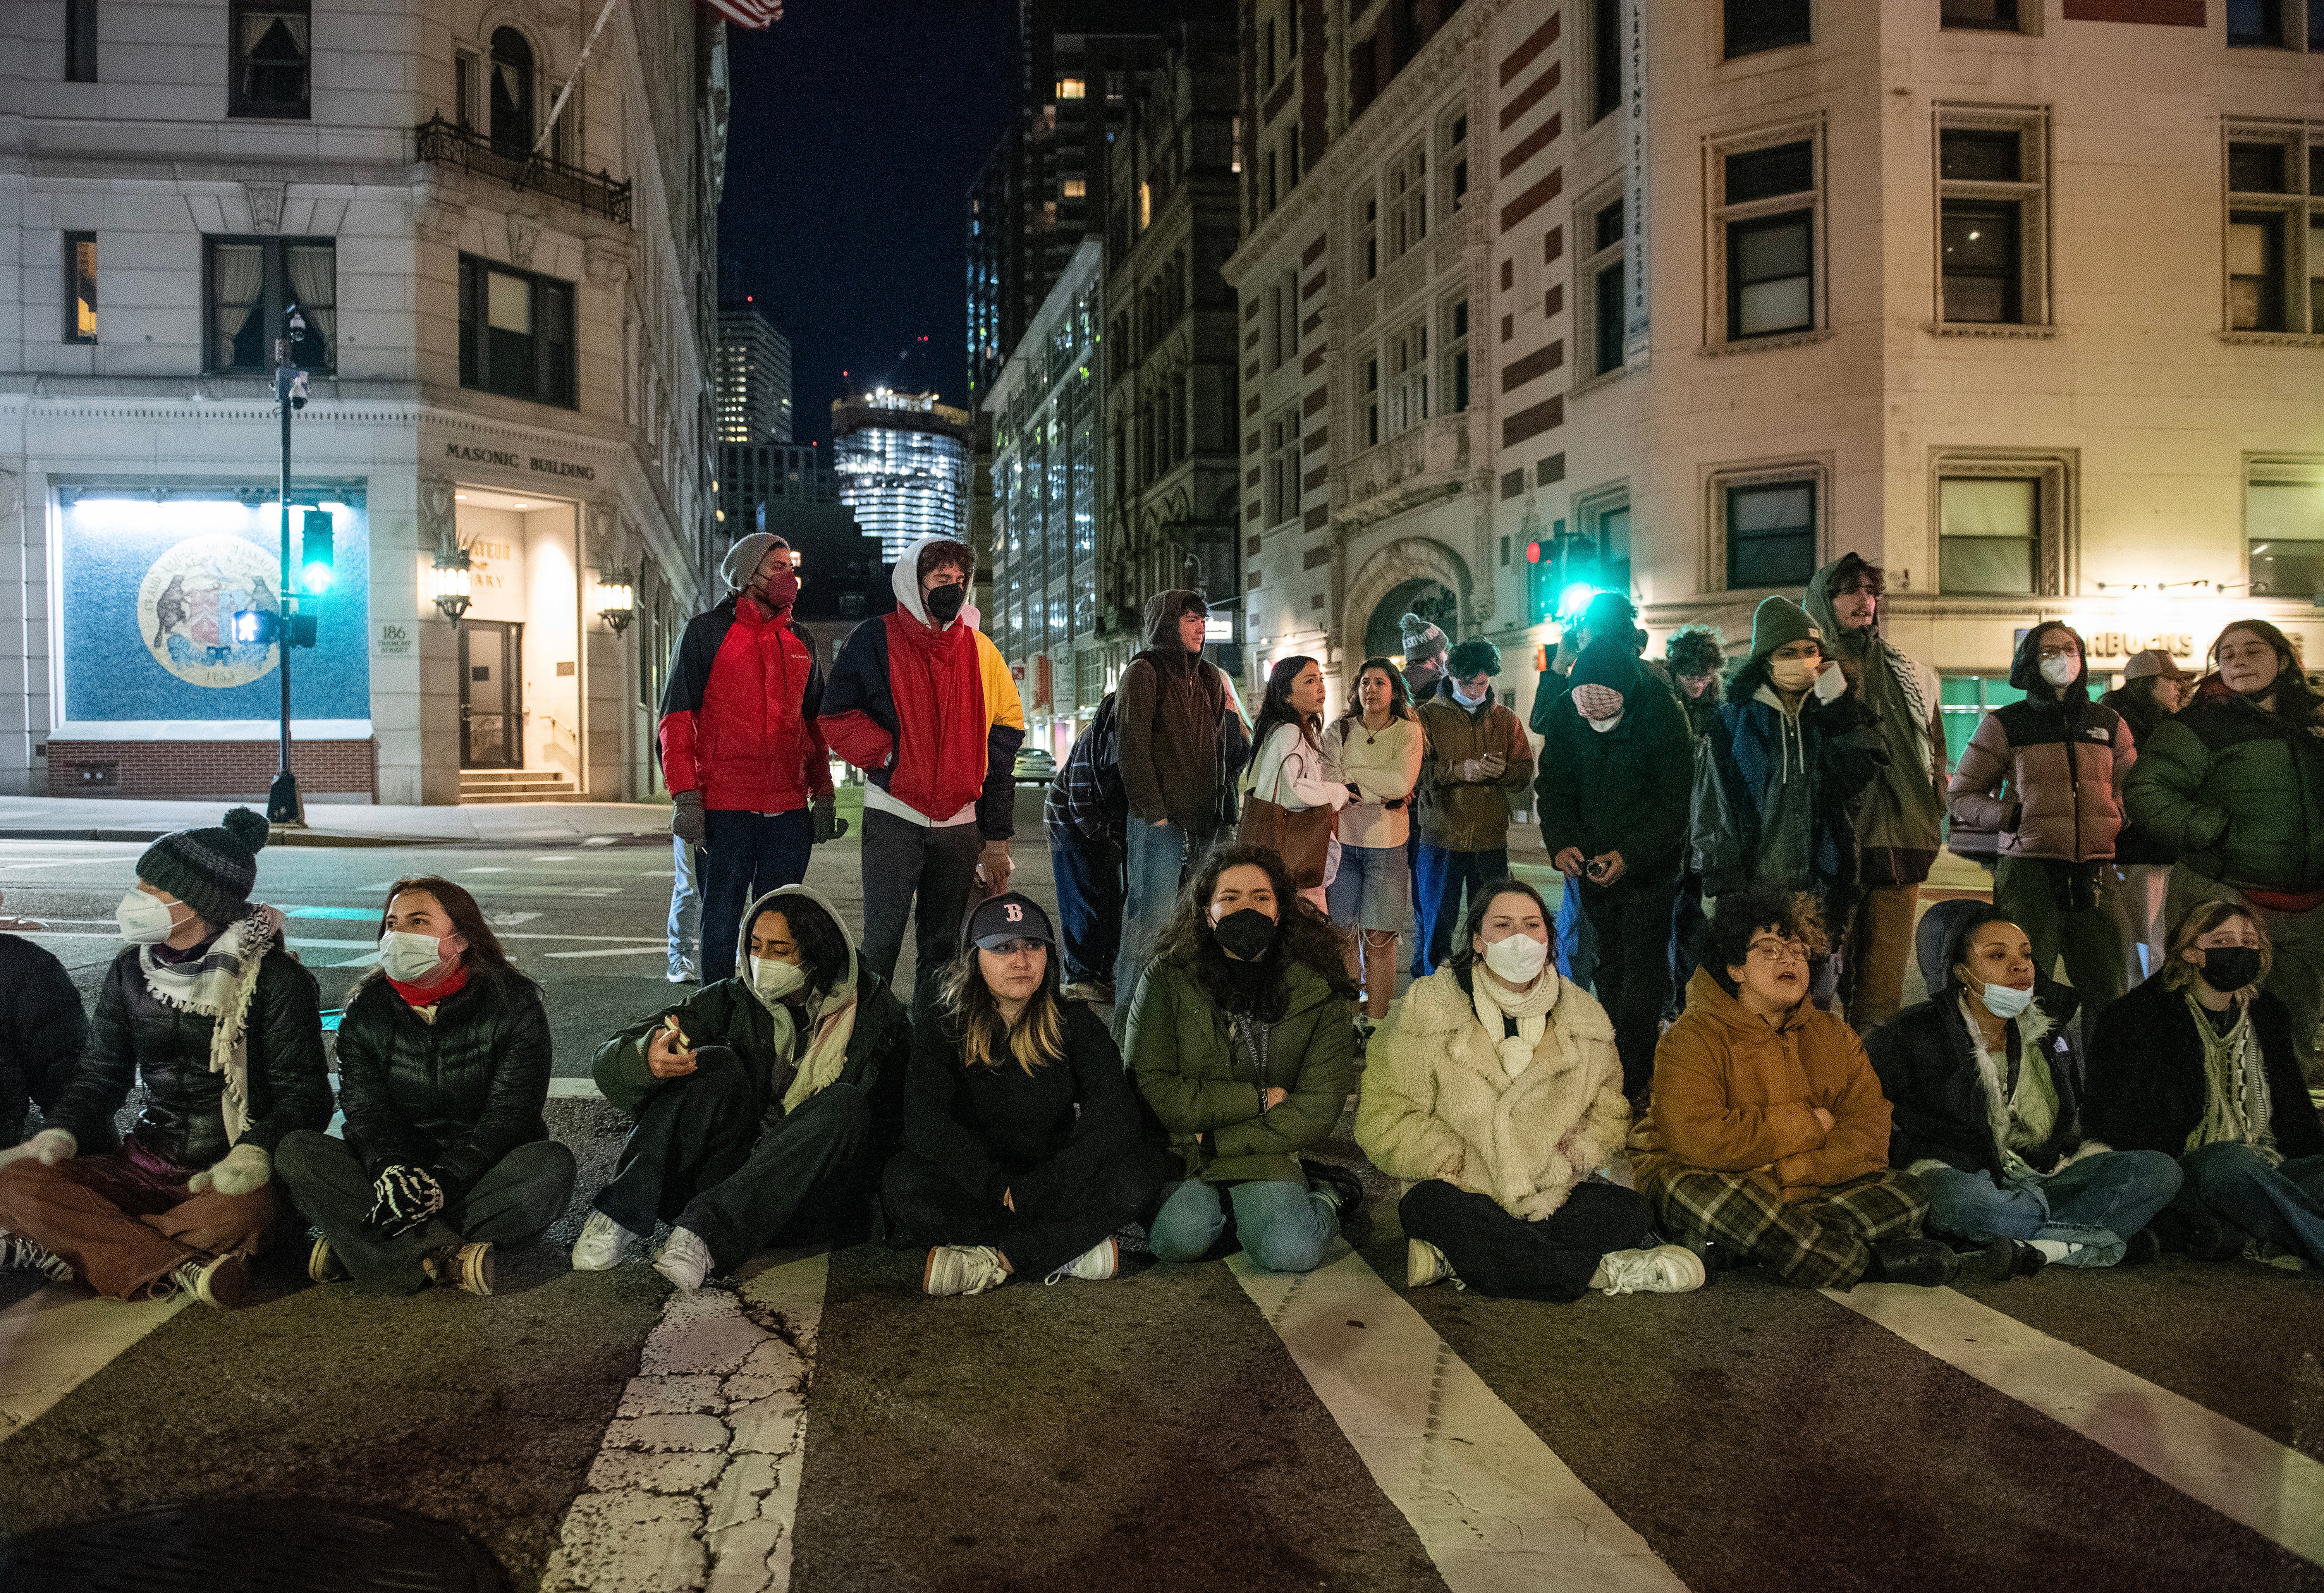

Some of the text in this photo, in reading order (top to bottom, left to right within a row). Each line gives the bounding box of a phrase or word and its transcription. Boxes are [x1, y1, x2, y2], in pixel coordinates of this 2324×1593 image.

[1633, 4, 1642, 118] LEASING
[446, 443, 595, 481] MASONIC BUILDING
[383, 625, 406, 640] 186
[1004, 903, 1023, 922] B
